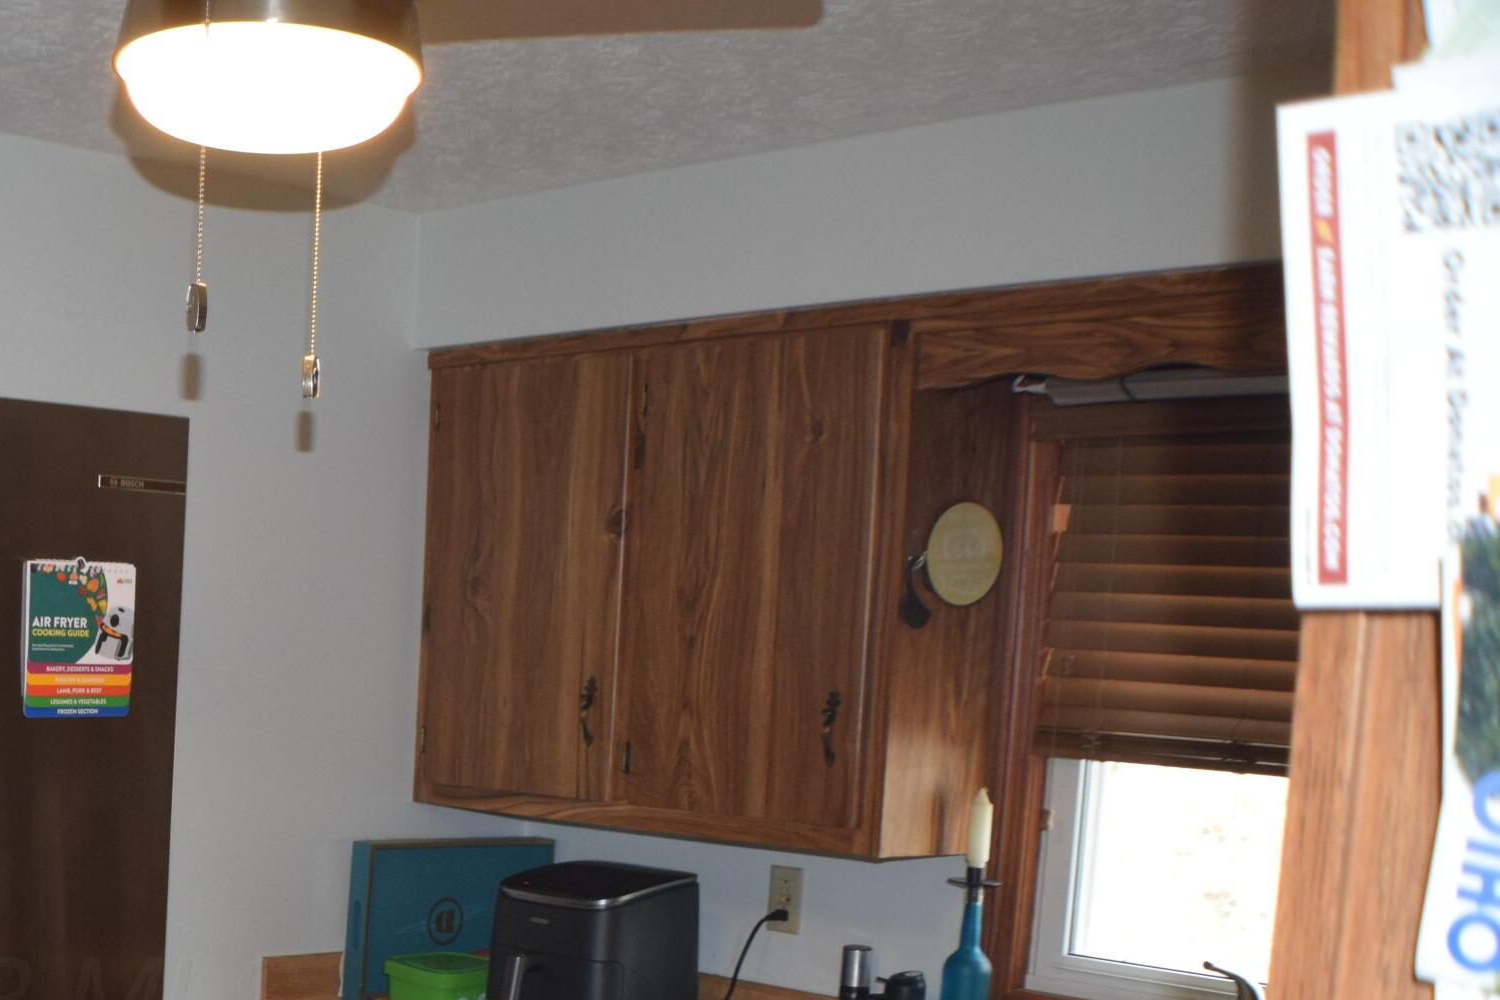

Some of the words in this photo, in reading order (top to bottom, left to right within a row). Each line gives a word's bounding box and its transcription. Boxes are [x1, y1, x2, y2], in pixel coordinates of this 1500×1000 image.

[32, 616, 51, 628] AIR
[54, 616, 88, 628] FRYER
[31, 628, 66, 637] COOKING
[67, 629, 90, 637] GUIDE
